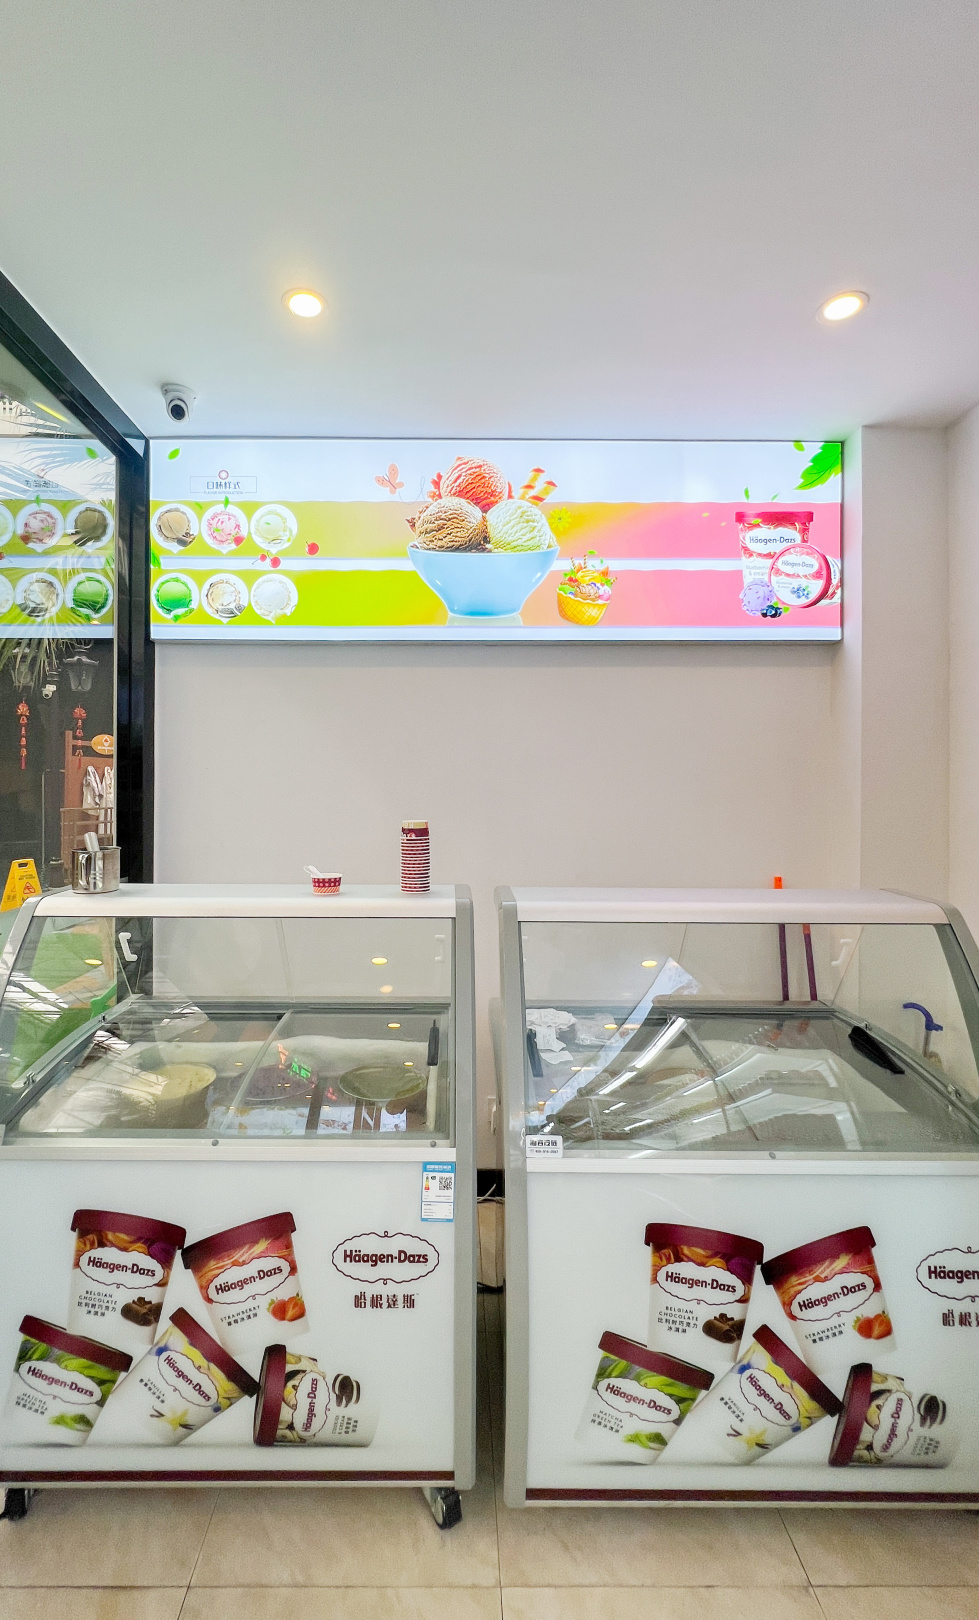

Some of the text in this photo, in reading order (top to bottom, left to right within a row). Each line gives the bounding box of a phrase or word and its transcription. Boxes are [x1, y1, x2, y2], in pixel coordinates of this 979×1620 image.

[85, 1290, 113, 1298] BELGIAN
[78, 1295, 118, 1305] CHOCOLATE
[220, 1305, 260, 1322] STRAWBERRY
[666, 1306, 694, 1314] BELGIAN
[658, 1312, 698, 1322] CHOCOLATE
[805, 1322, 846, 1339] STRAWBERRY
[728, 1397, 744, 1416] VANILLA
[593, 1414, 611, 1424] GREEN
[599, 1410, 622, 1423] MATCHA
